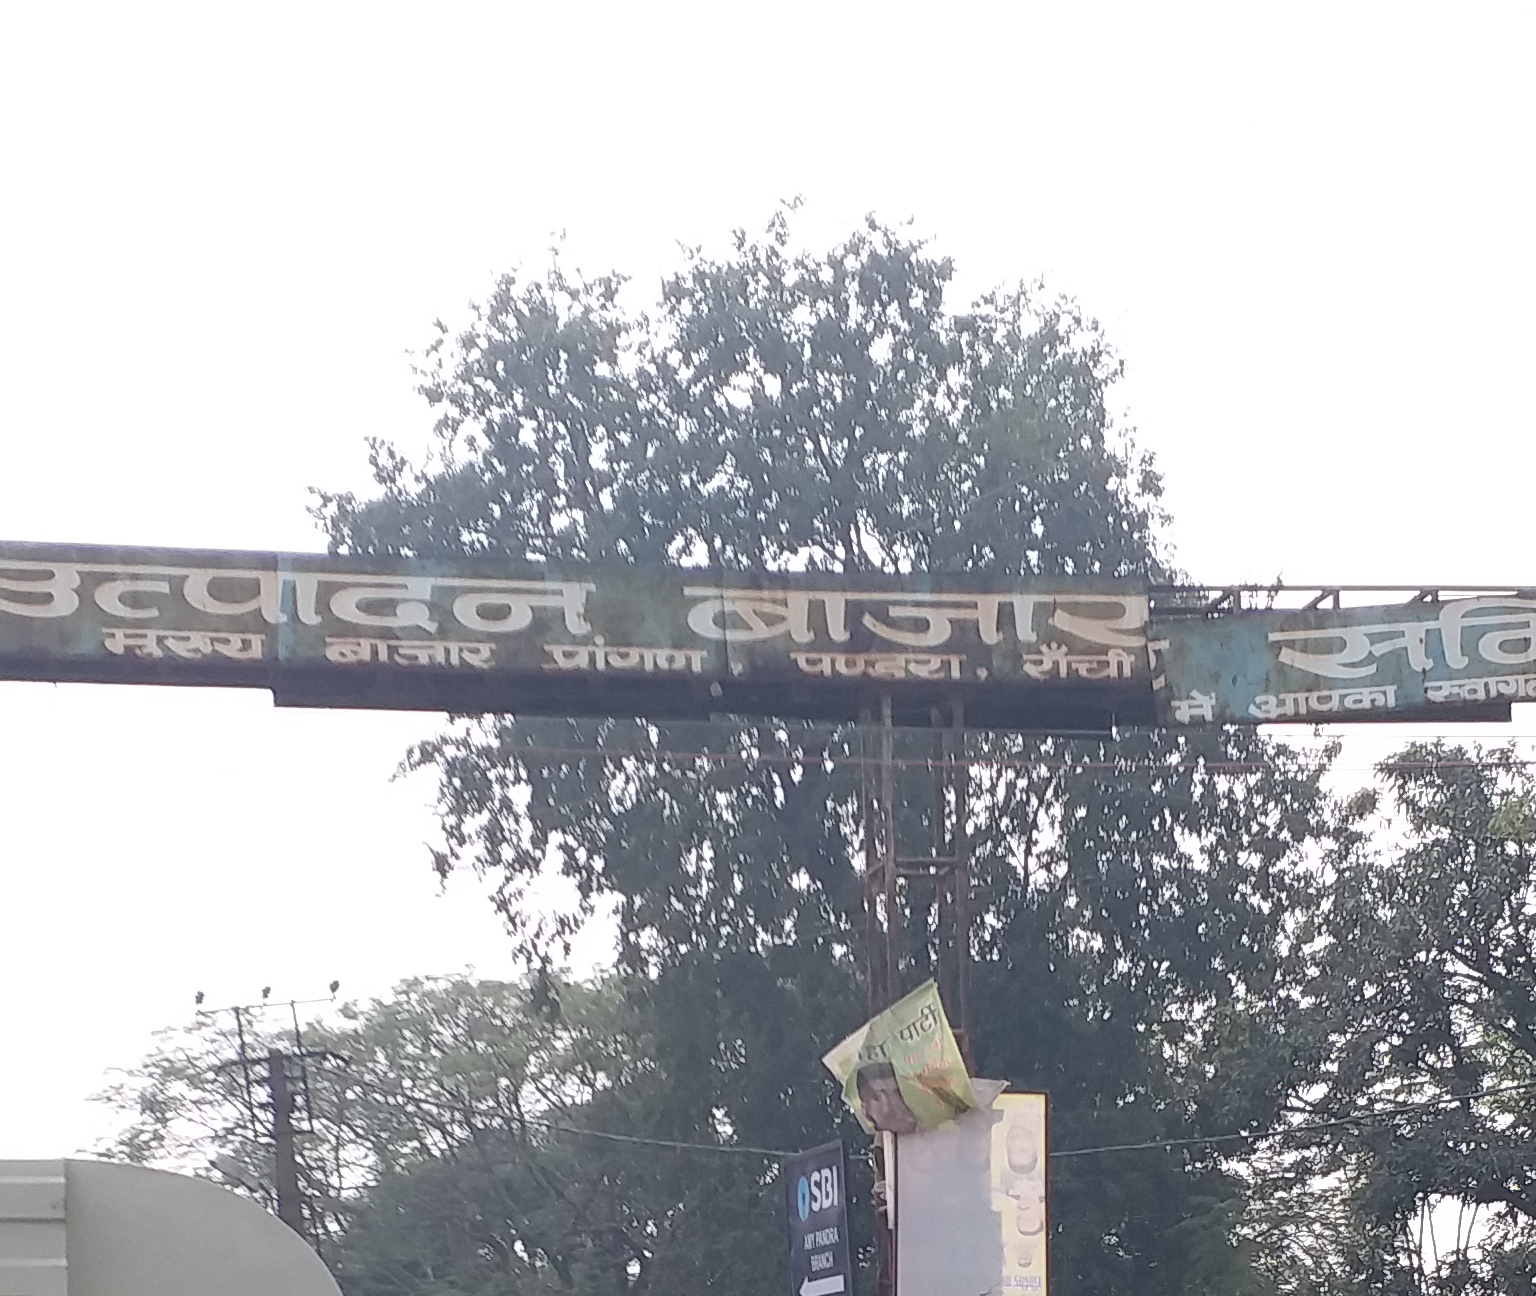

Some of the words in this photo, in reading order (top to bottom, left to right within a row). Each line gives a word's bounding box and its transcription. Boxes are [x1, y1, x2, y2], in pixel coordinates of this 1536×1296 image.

[325, 637, 496, 669] बाजार
[1248, 685, 1397, 719] आपका
[810, 1165, 839, 1212] SBI
[810, 1251, 834, 1272] BRANCH
